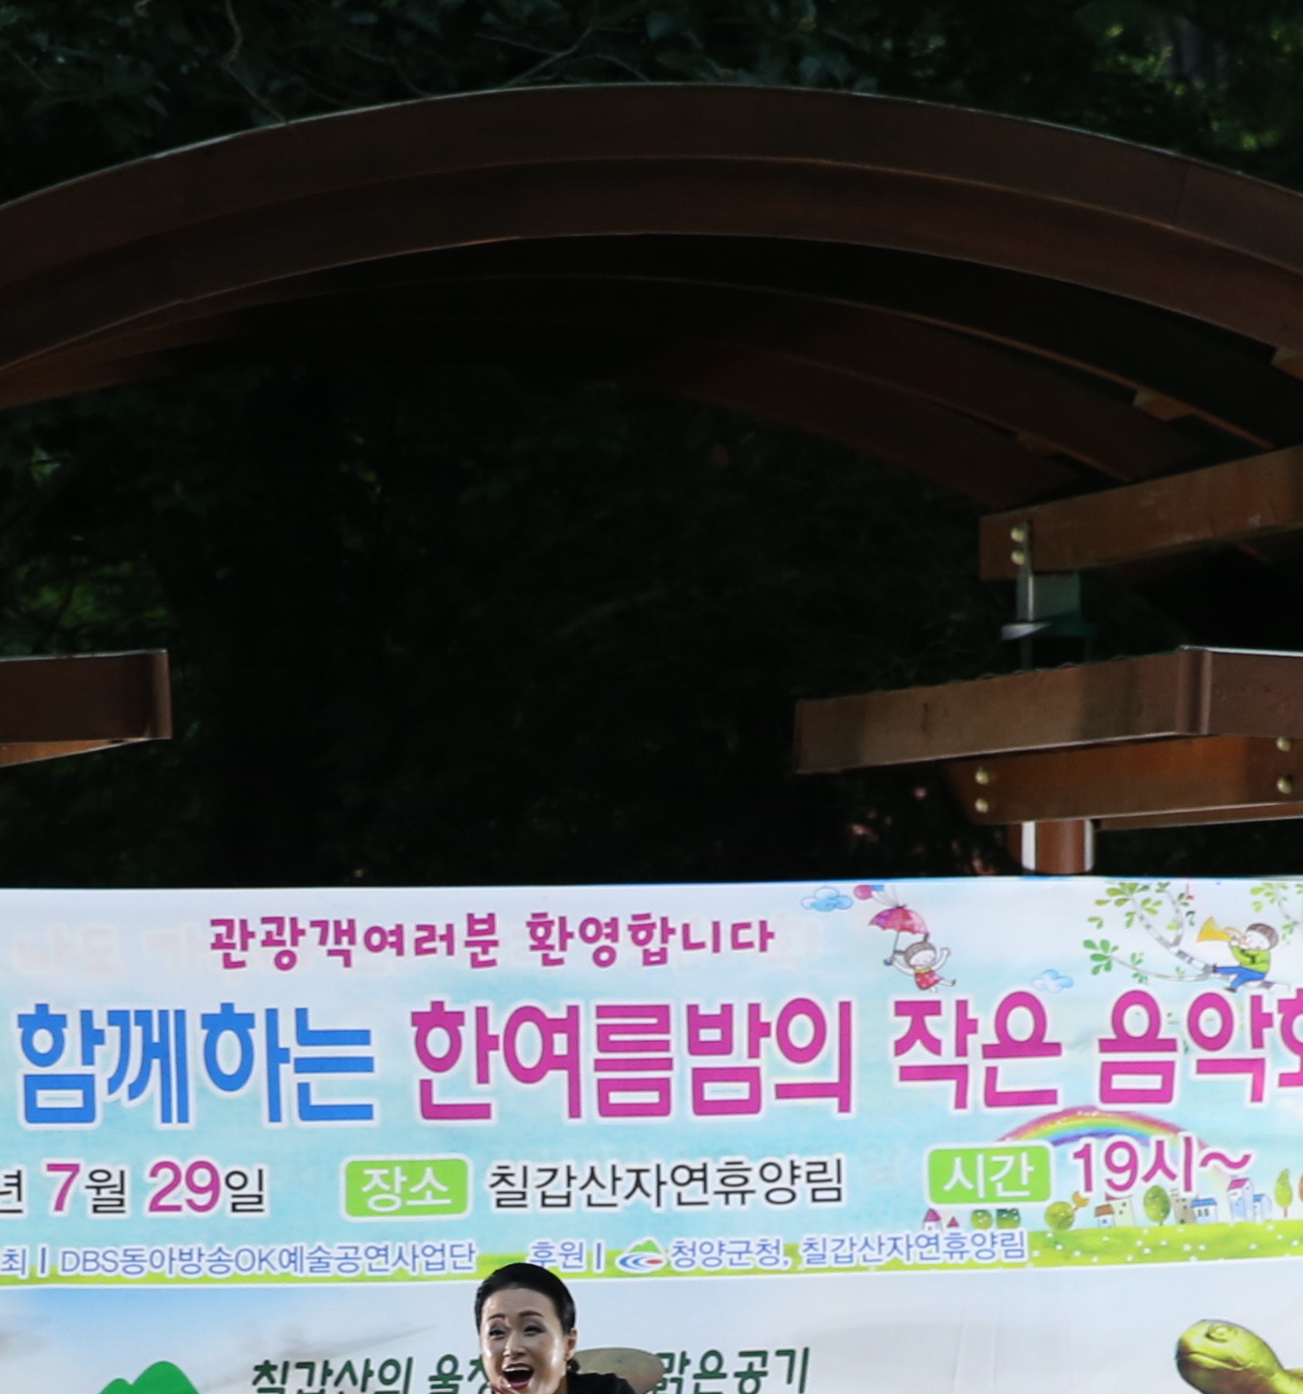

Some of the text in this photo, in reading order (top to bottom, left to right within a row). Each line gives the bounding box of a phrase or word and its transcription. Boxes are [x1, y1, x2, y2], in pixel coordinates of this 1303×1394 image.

[209, 912, 775, 970] 관광객여러분 환영합니다
[17, 1003, 375, 1124] 함께하는
[410, 998, 853, 1120] 한여름밤의
[893, 990, 1063, 1109] 작은
[45, 1163, 127, 1215] 7월
[149, 1160, 265, 1214] 29일
[361, 1157, 844, 1212] 장소 칠갑산자연휴양림
[942, 1136, 1252, 1198] 시간 19시~
[529, 1231, 1027, 1270] 후원 청양군청, 칠갑산자연휴양림
